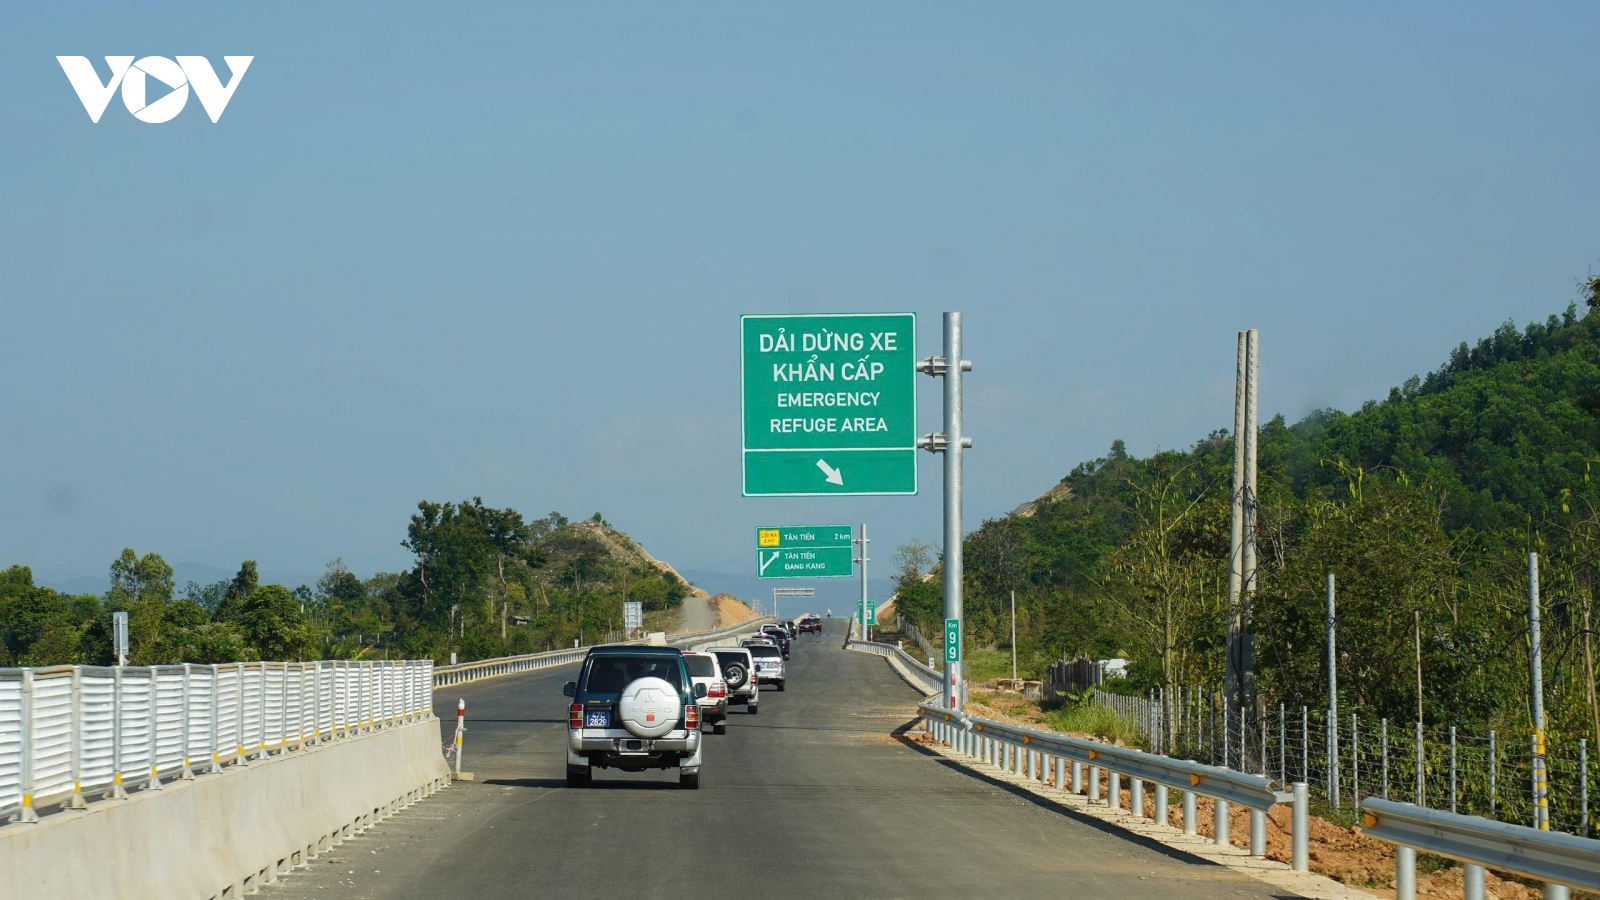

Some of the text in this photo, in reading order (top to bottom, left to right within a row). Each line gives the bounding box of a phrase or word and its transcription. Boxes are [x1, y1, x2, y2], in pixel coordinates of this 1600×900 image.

[760, 327, 897, 352] DẢI DỪNG XE
[773, 354, 884, 382] KHẨN CẤP
[777, 392, 880, 407] EMERGENCY
[770, 417, 888, 433] REFUGE AREA
[784, 533, 798, 541] TÂN
[800, 531, 815, 541] TIẾN
[785, 551, 815, 560] TÂN TIẾN
